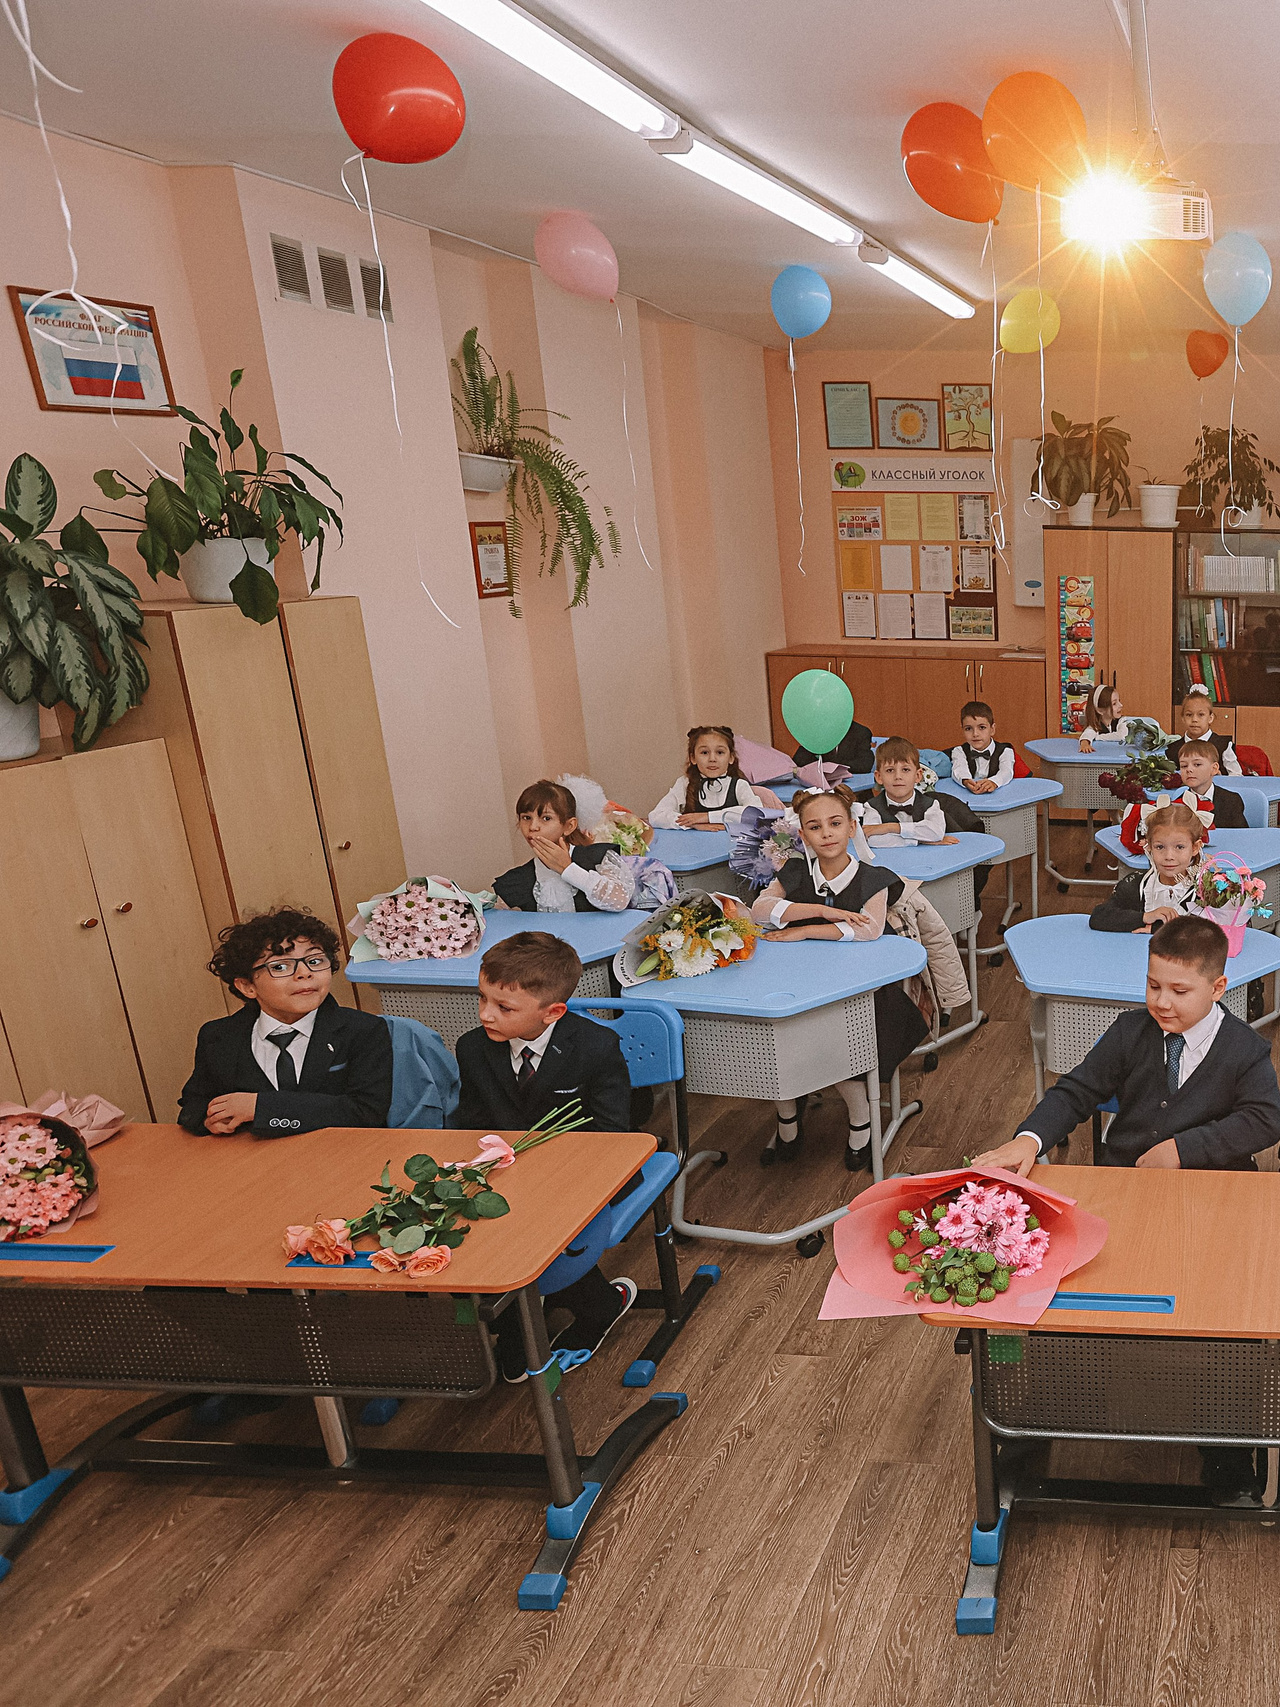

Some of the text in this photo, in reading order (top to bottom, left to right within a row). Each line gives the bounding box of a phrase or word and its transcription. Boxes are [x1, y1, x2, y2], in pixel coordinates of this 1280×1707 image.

[34, 316, 148, 338] РОССИЙСКОЙ ФЕДРАЦИИ
[871, 468, 985, 480] КЛАССНЫЙ УГОЛОК
